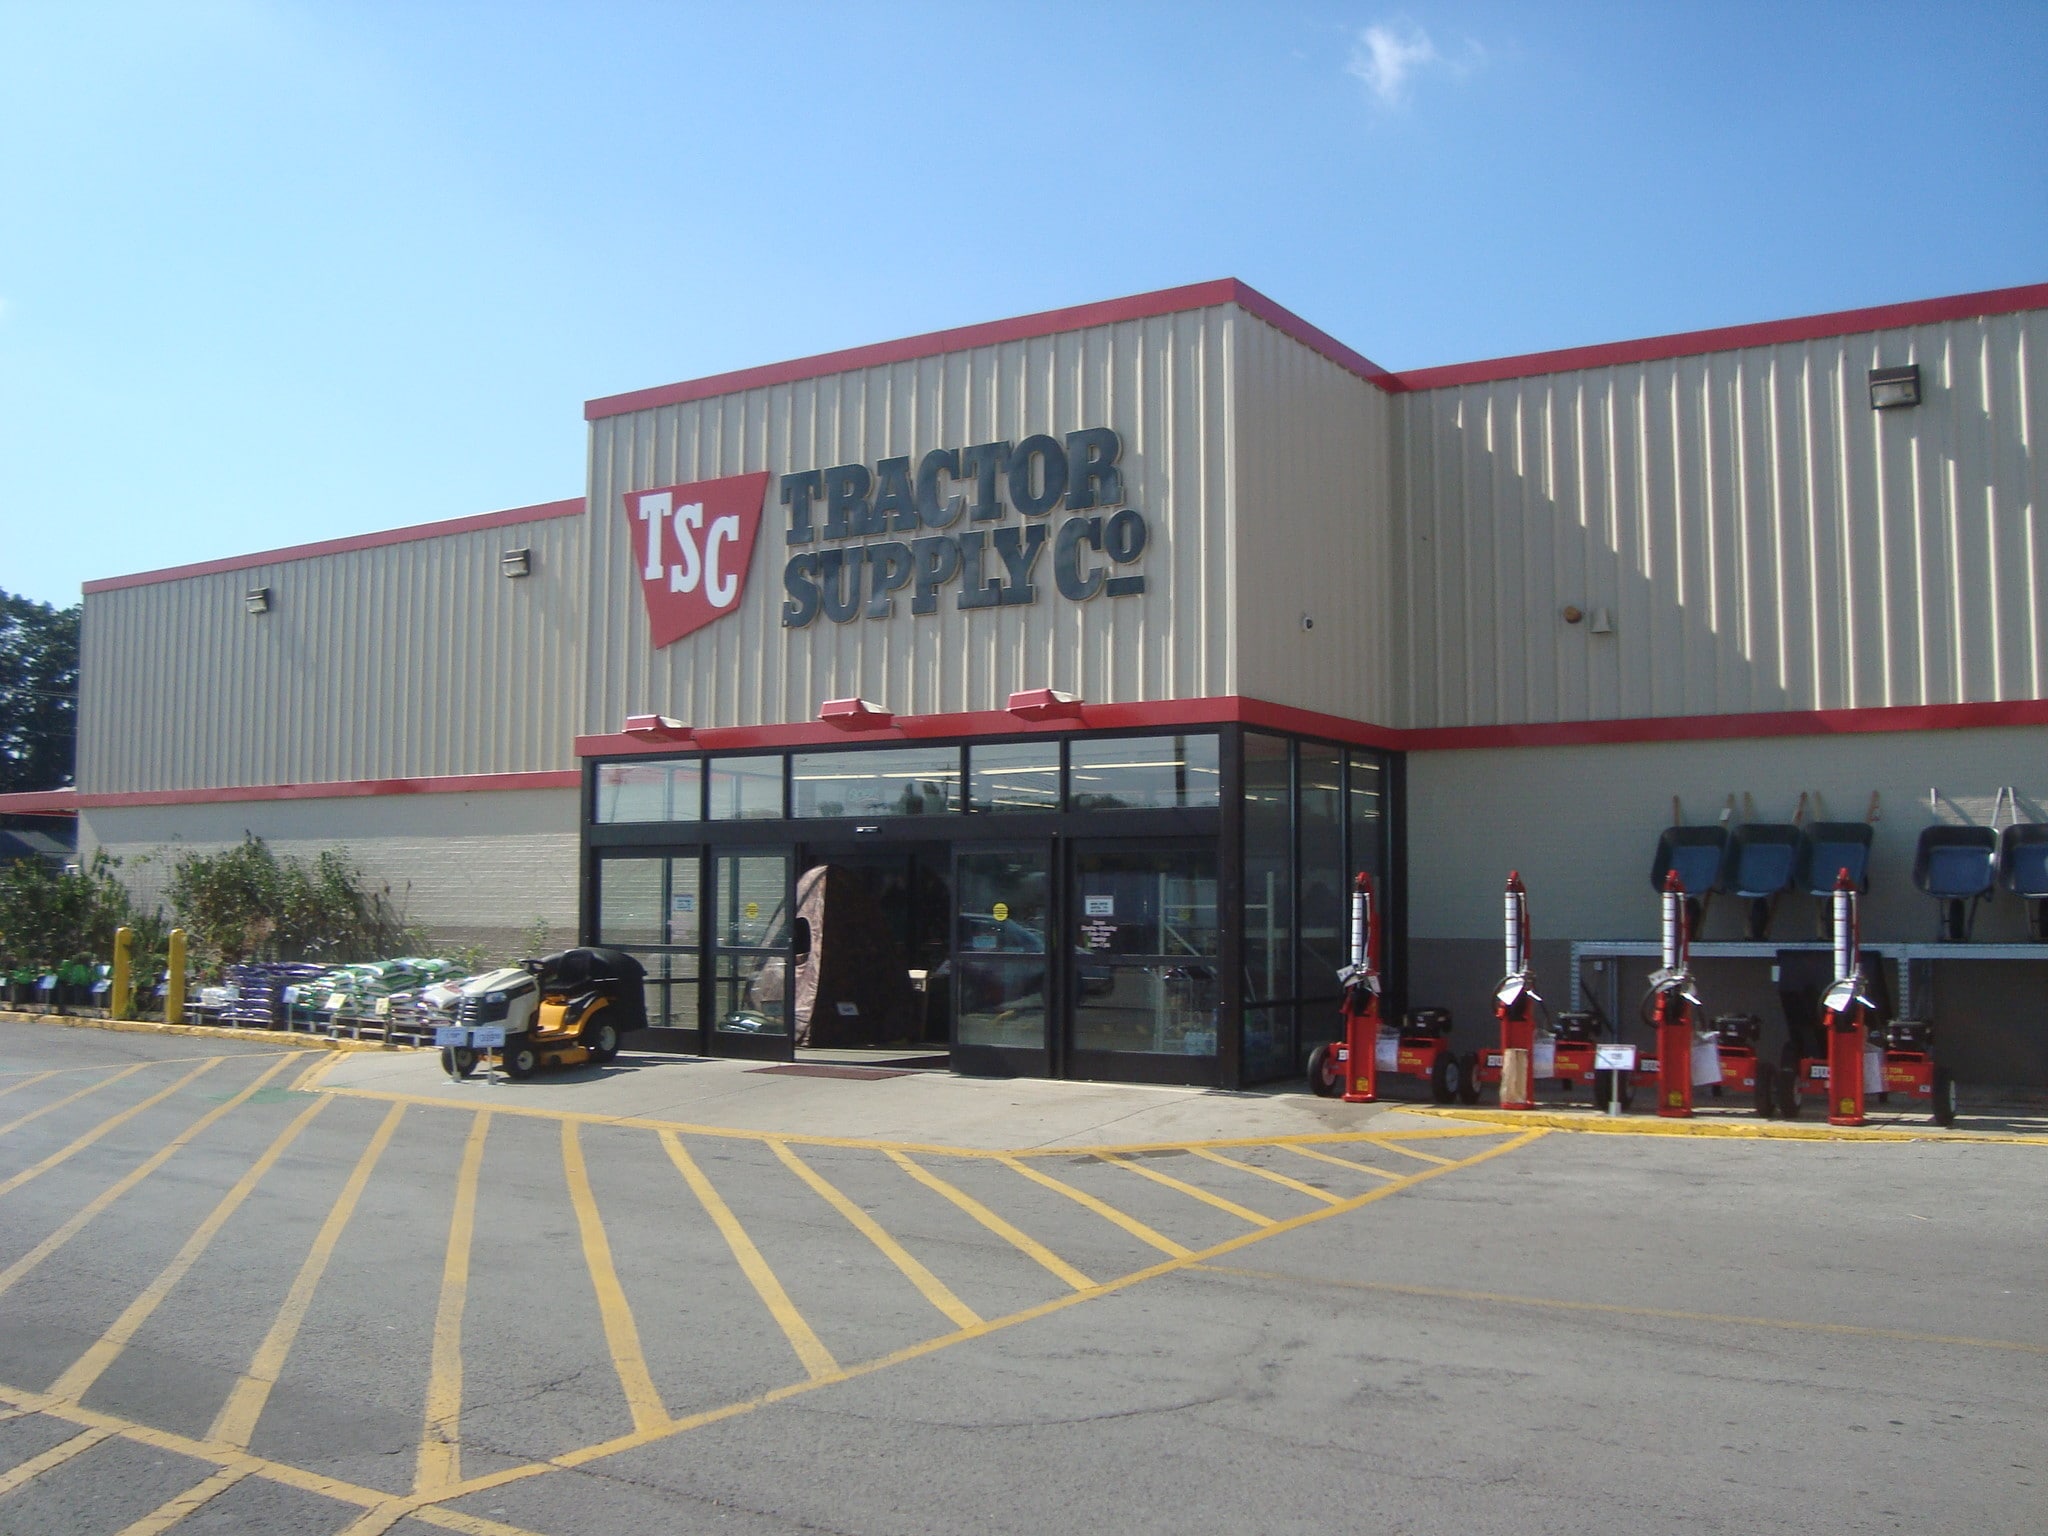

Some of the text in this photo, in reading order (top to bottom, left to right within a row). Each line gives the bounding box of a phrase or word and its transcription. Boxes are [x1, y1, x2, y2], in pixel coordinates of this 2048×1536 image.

[780, 427, 1124, 545] TRACTOR
[639, 491, 740, 608] TSC
[782, 523, 1046, 628] SUPPLY
